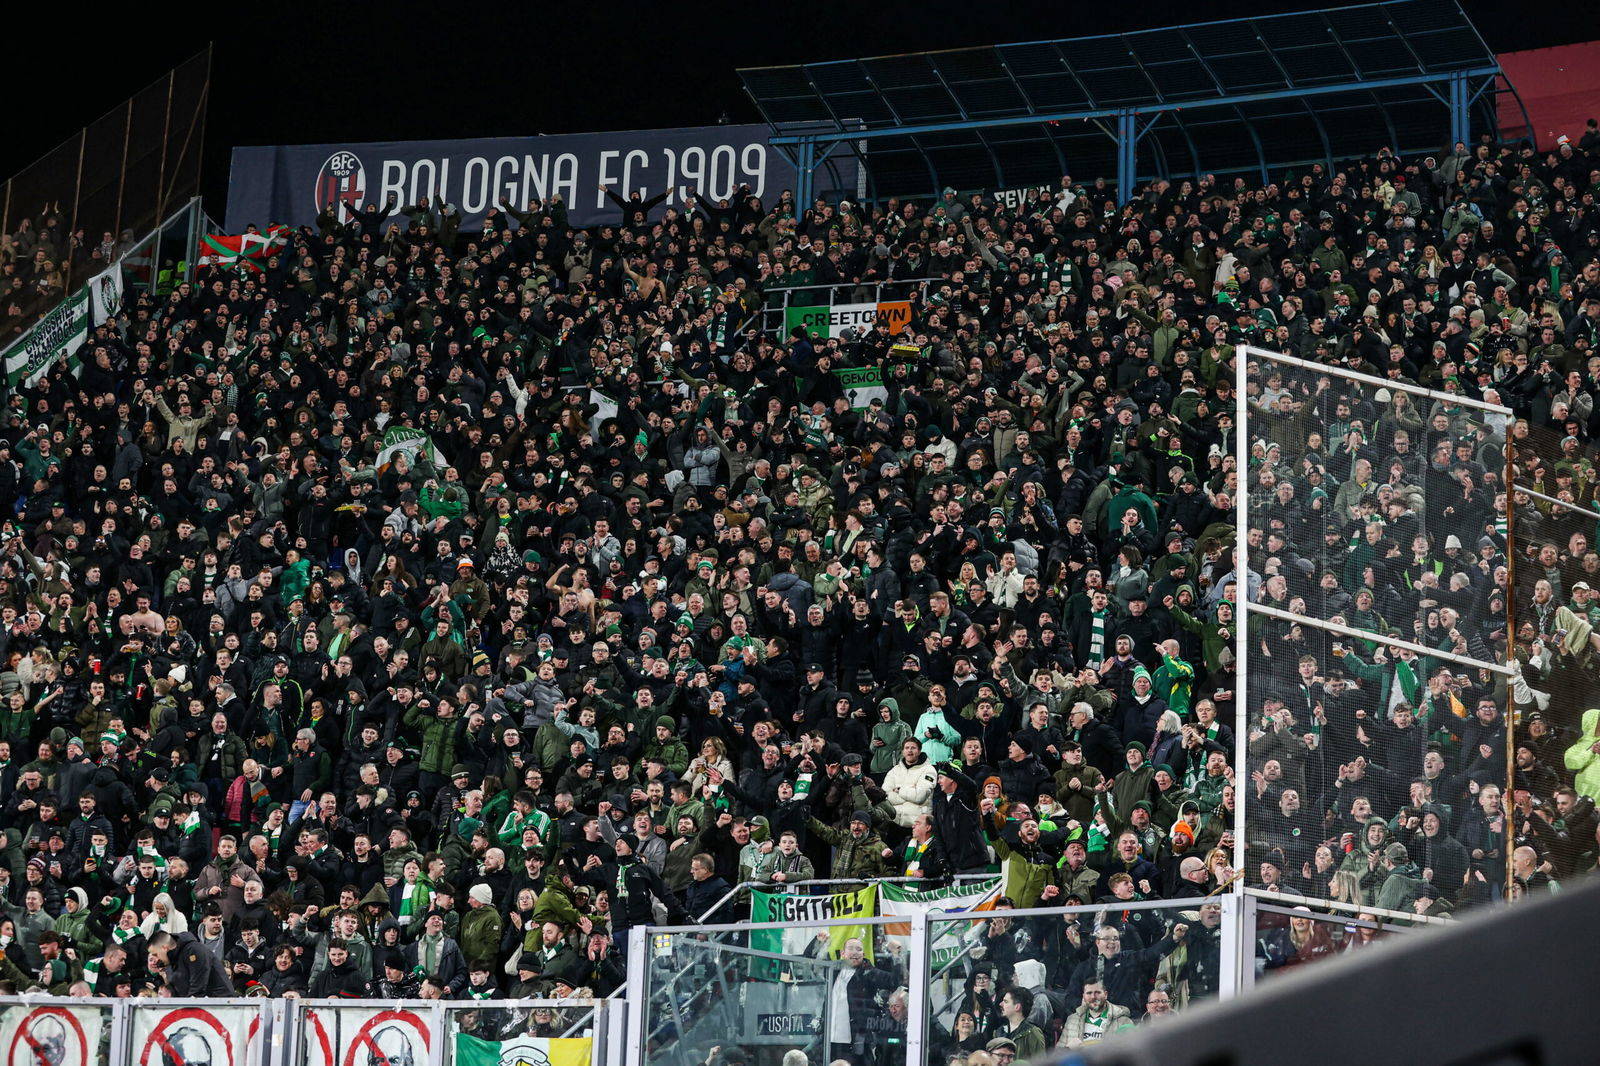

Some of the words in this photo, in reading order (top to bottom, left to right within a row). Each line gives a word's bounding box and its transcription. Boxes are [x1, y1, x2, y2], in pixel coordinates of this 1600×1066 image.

[331, 154, 355, 170] BFC
[380, 153, 579, 217] BOLOGNA
[597, 150, 649, 208] FC
[664, 143, 767, 203] 1909
[24, 299, 75, 354] CRAIGSHILL
[803, 308, 906, 326] CREETOWN
[27, 316, 76, 372] SHAMROCK
[768, 891, 864, 922] SIGHTHILL
[768, 1015, 804, 1033] USCITA
